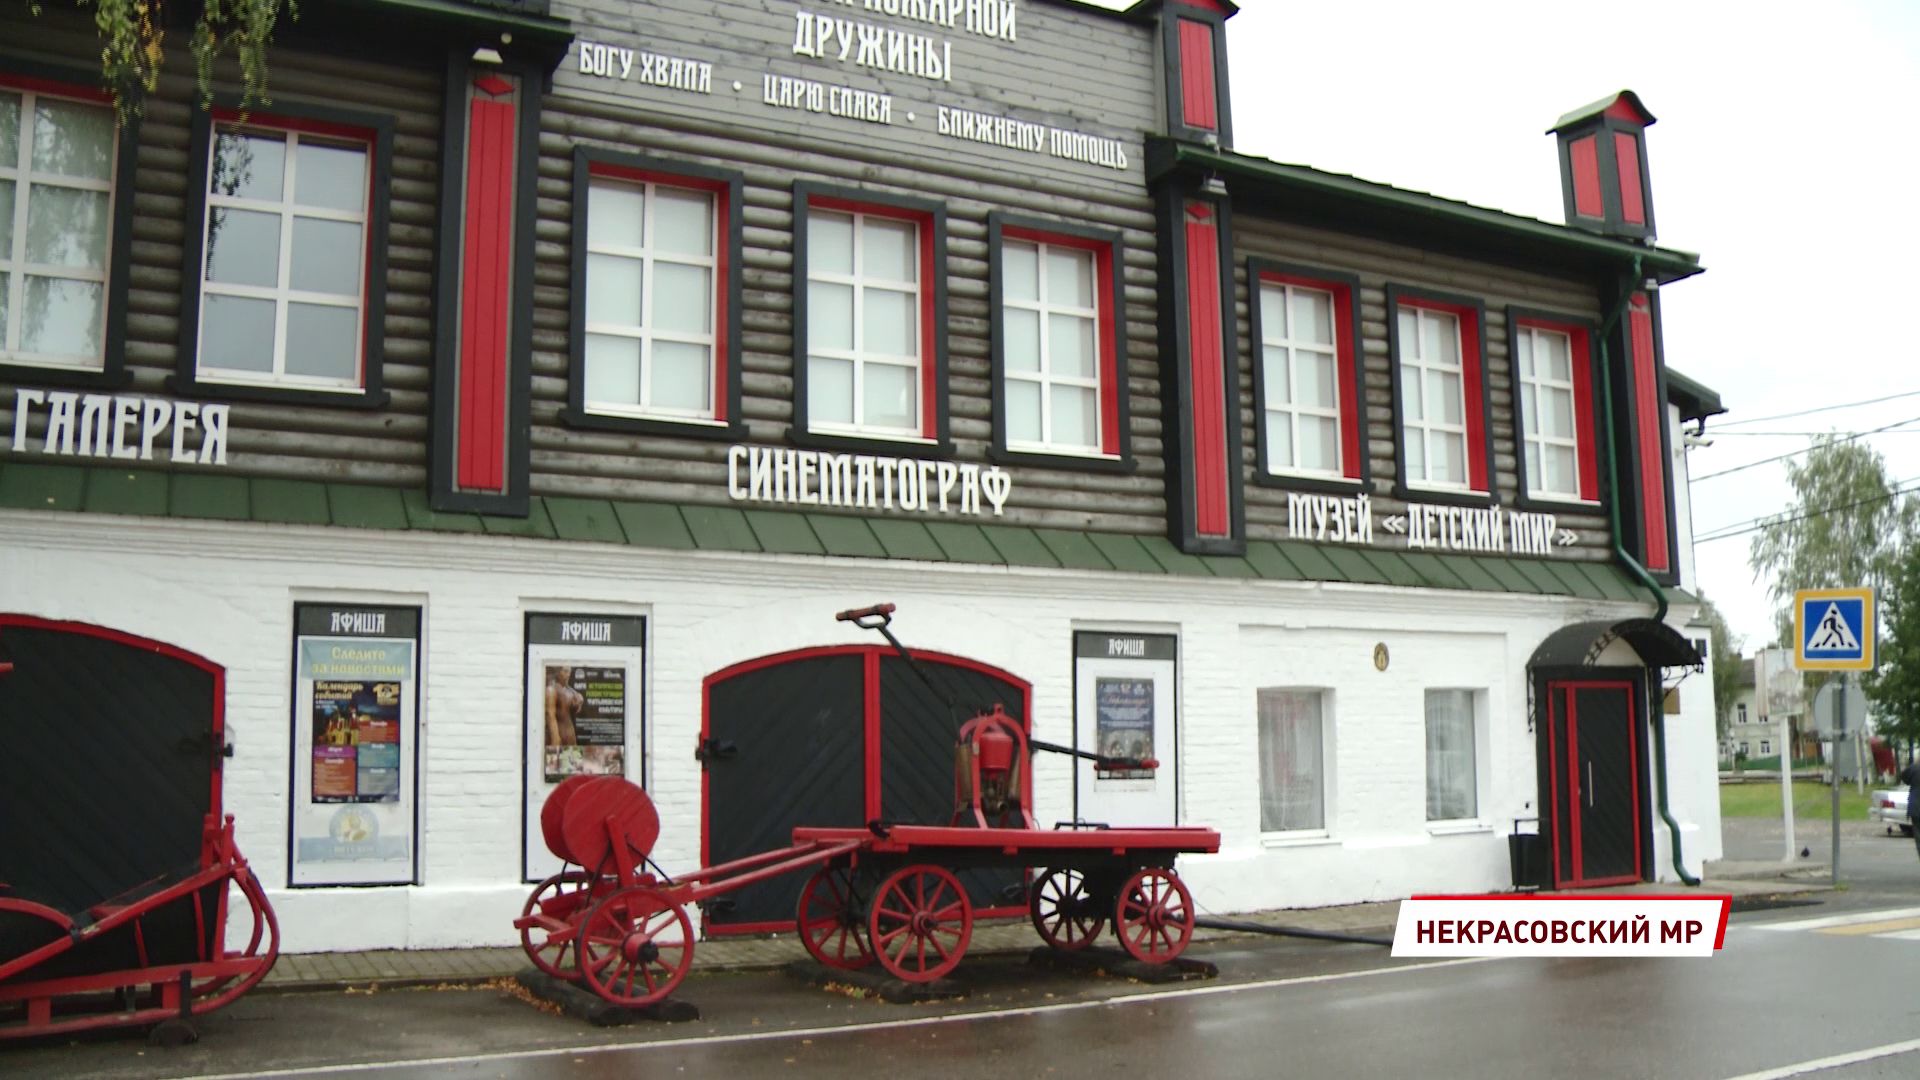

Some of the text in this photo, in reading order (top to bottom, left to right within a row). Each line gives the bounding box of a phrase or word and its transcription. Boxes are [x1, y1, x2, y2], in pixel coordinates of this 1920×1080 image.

[864, 0, 1017, 41] ЖАРНОЙ
[579, 42, 713, 93] БОГУ ХВАЛА
[793, 11, 952, 82] ДРУЖИНЫ
[763, 74, 893, 124] ЦАРЮ СЛАВА
[937, 105, 1129, 170] БЛИЖНЕМУ ПОМОЩЬ
[11, 388, 231, 466] ГАЛЕРЕЯ
[728, 444, 1012, 516] СИНЕМАТОГРАФ
[1287, 492, 1579, 555] МУЗЕЙ «ДЕТСКИЙ МИР»
[331, 612, 386, 633] АФИША
[561, 621, 612, 642] АФИША
[1108, 638, 1145, 656] АФИША
